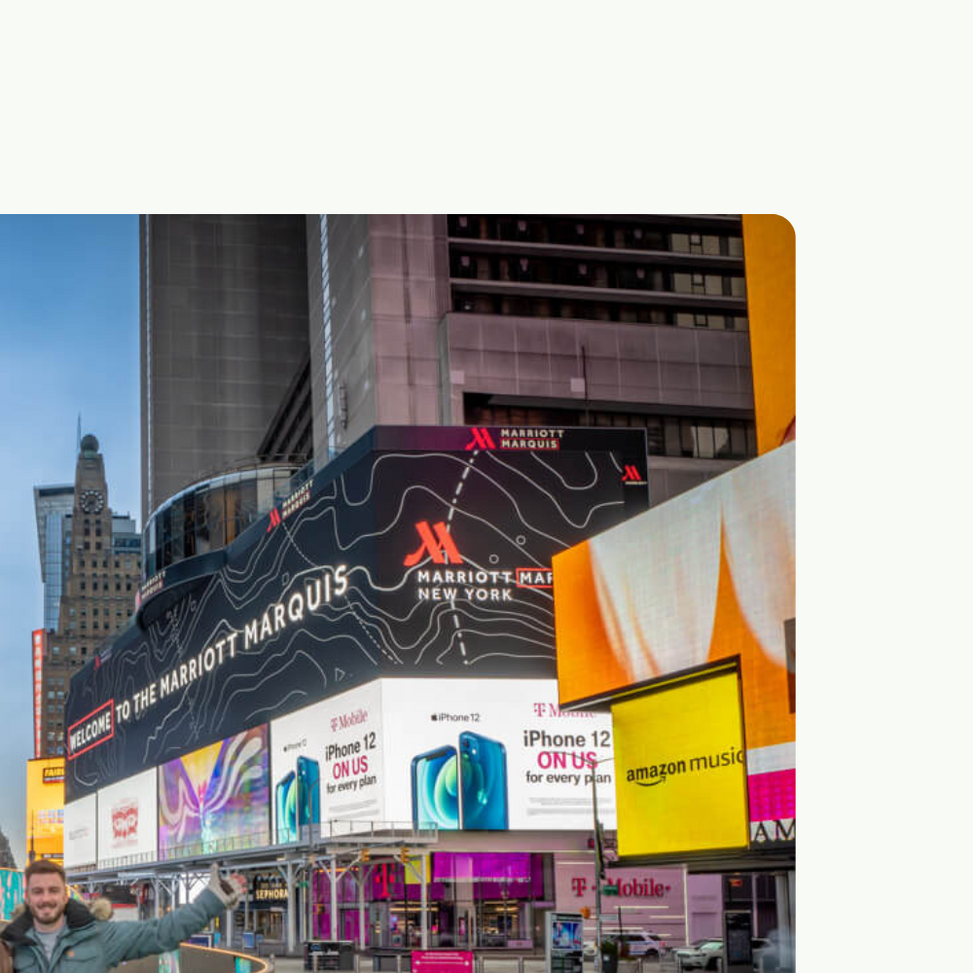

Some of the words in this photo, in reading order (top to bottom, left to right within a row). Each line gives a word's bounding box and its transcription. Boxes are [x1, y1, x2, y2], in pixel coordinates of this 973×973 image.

[500, 429, 564, 438] MARRIOTT
[501, 440, 557, 449] MARQUIS
[418, 570, 513, 584] MARRIOTT
[418, 587, 457, 601] NEW
[464, 587, 513, 601] YORK
[70, 711, 112, 752] WELCOME
[116, 700, 131, 724] TO
[133, 682, 158, 714] THE
[160, 632, 239, 699] MARRIOTT
[244, 564, 348, 650] MARQUIS
[438, 713, 470, 723] iPhone
[470, 713, 480, 722] 12
[325, 740, 361, 761] iPhone
[363, 731, 377, 751] 12
[523, 730, 586, 748] iPhone
[591, 730, 611, 748] 12
[332, 760, 350, 780] ON
[351, 754, 369, 776] US
[537, 751, 567, 769] ON
[572, 751, 599, 770] US
[526, 771, 543, 783] for
[546, 773, 580, 786] every
[584, 770, 612, 786] pan
[626, 758, 687, 782] amazon
[337, 778, 358, 792] every
[359, 775, 377, 789] plan
